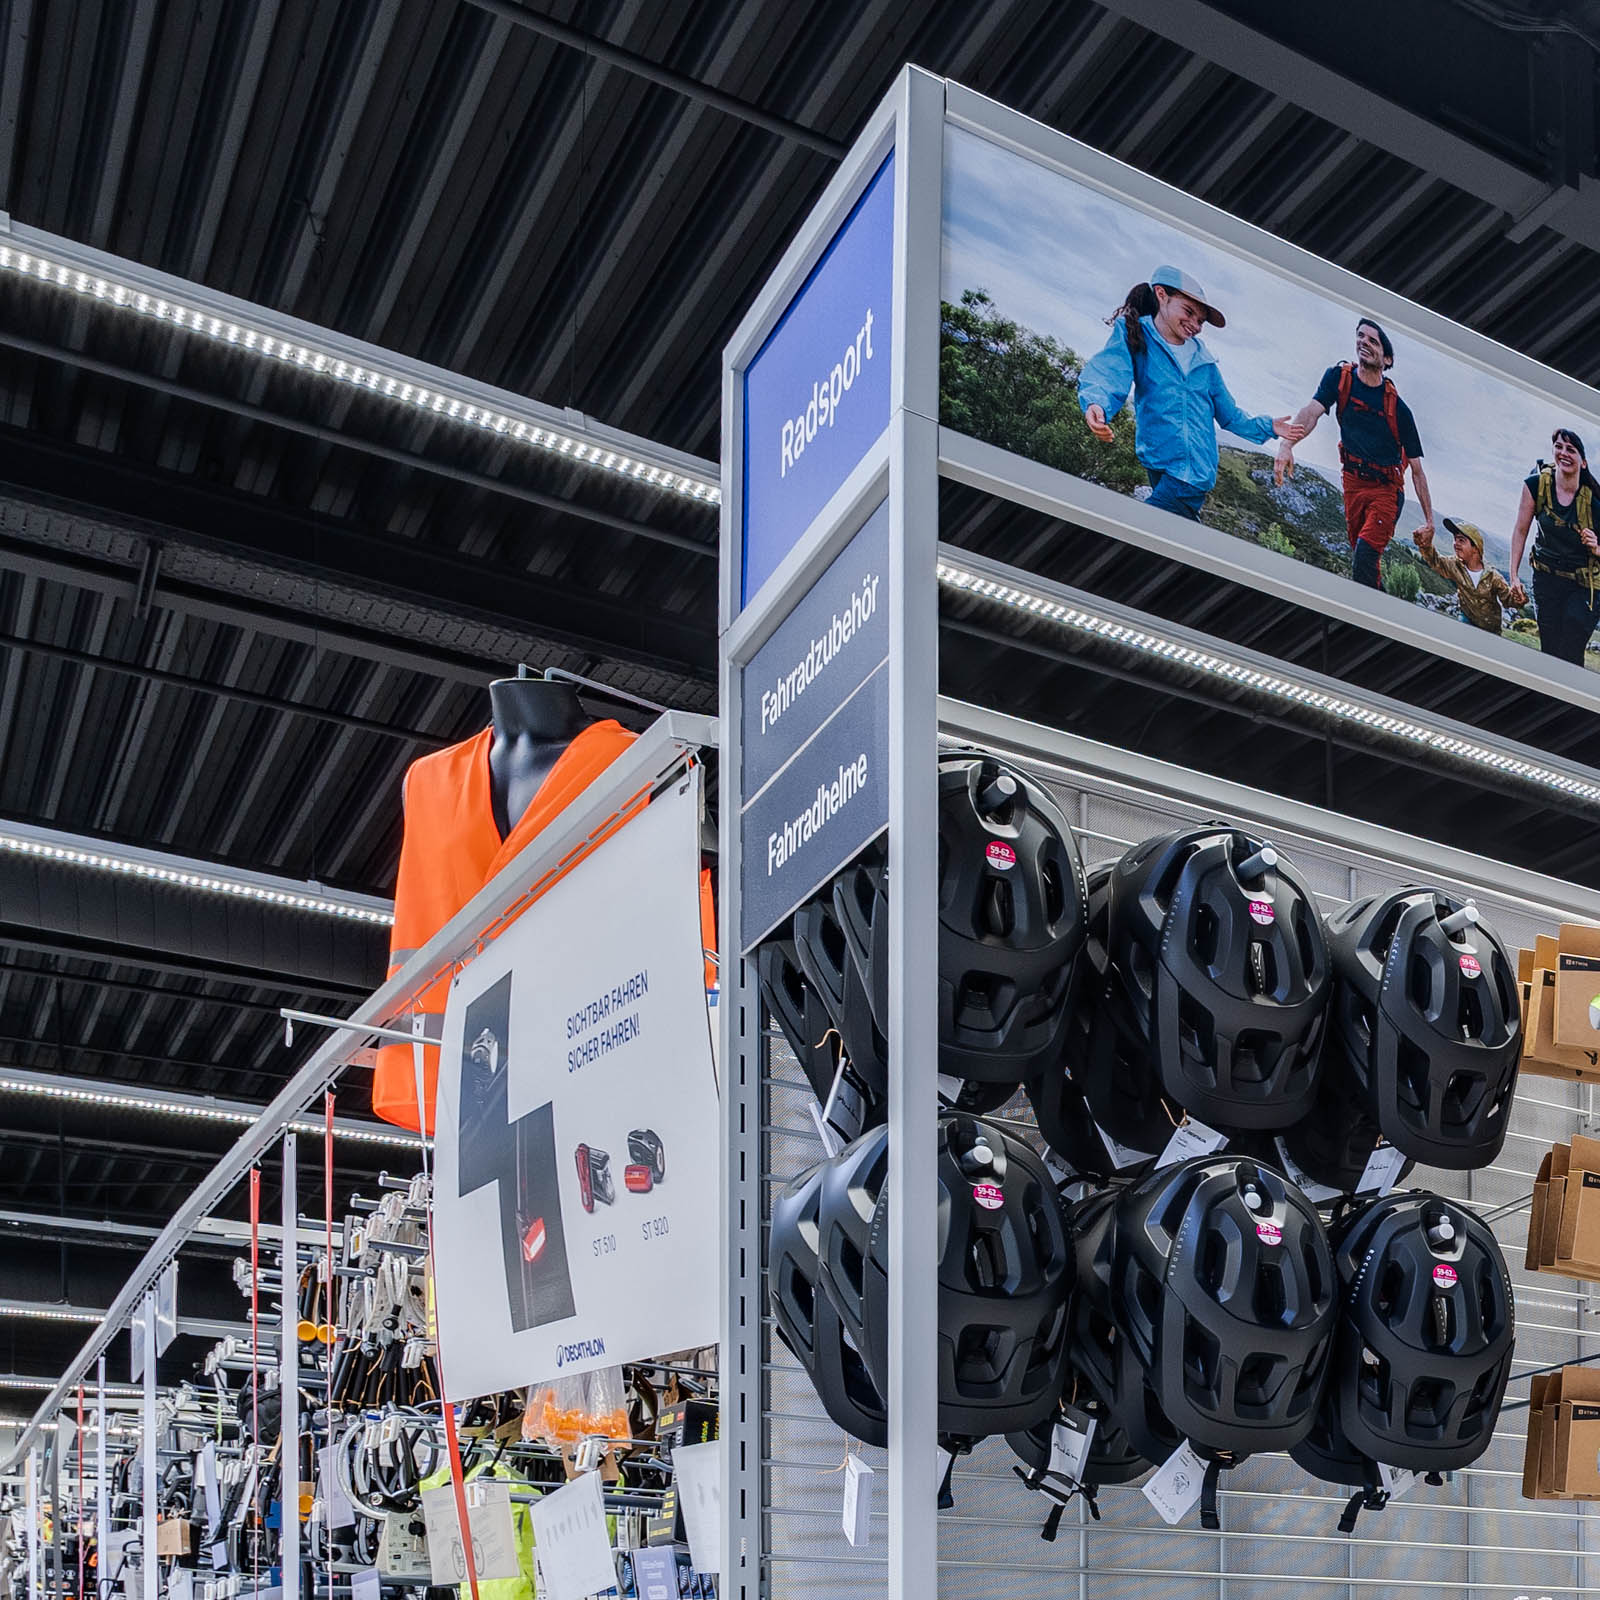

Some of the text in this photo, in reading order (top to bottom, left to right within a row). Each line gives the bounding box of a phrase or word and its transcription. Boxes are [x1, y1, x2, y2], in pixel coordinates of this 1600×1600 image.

[780, 307, 874, 479] Radsport
[760, 573, 880, 735] Fahrradzubehör
[767, 753, 868, 877] Fahrradhelme
[990, 844, 1010, 857] 59-62
[566, 969, 649, 1040] SICHTBAR FAHREN
[567, 1012, 640, 1073] SICHER FAHREN!
[870, 1185, 889, 1246] OCKRIDER
[563, 1336, 606, 1363] DECATHLON
